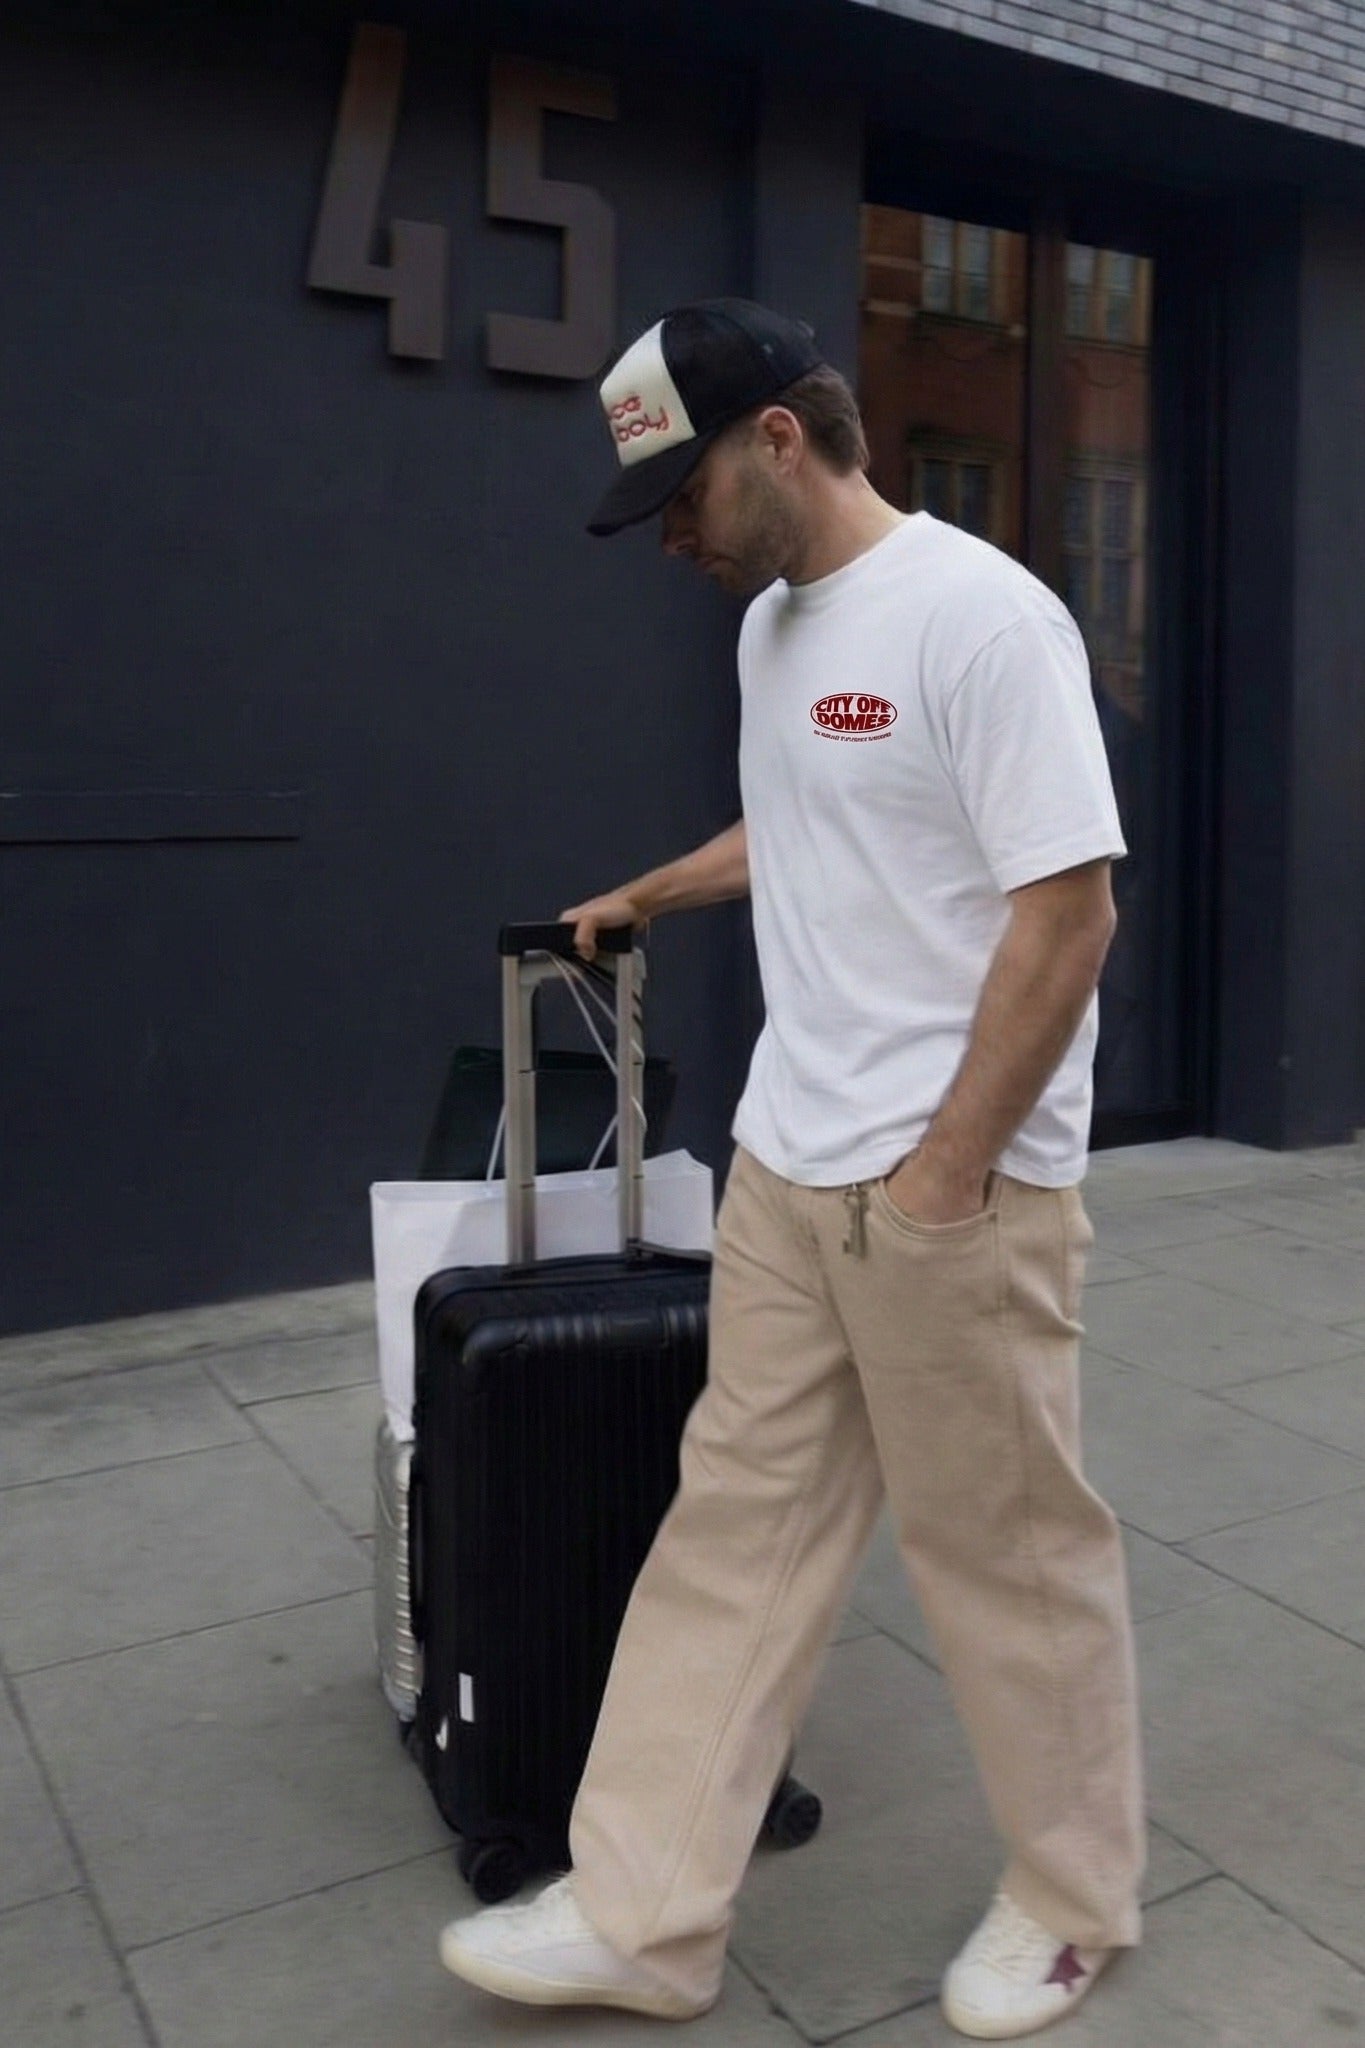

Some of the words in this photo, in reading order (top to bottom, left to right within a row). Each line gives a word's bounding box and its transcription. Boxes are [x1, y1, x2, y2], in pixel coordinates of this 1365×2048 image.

[307, 21, 617, 379] 45
[815, 695, 854, 713] CITY
[816, 712, 891, 731] DOMES
